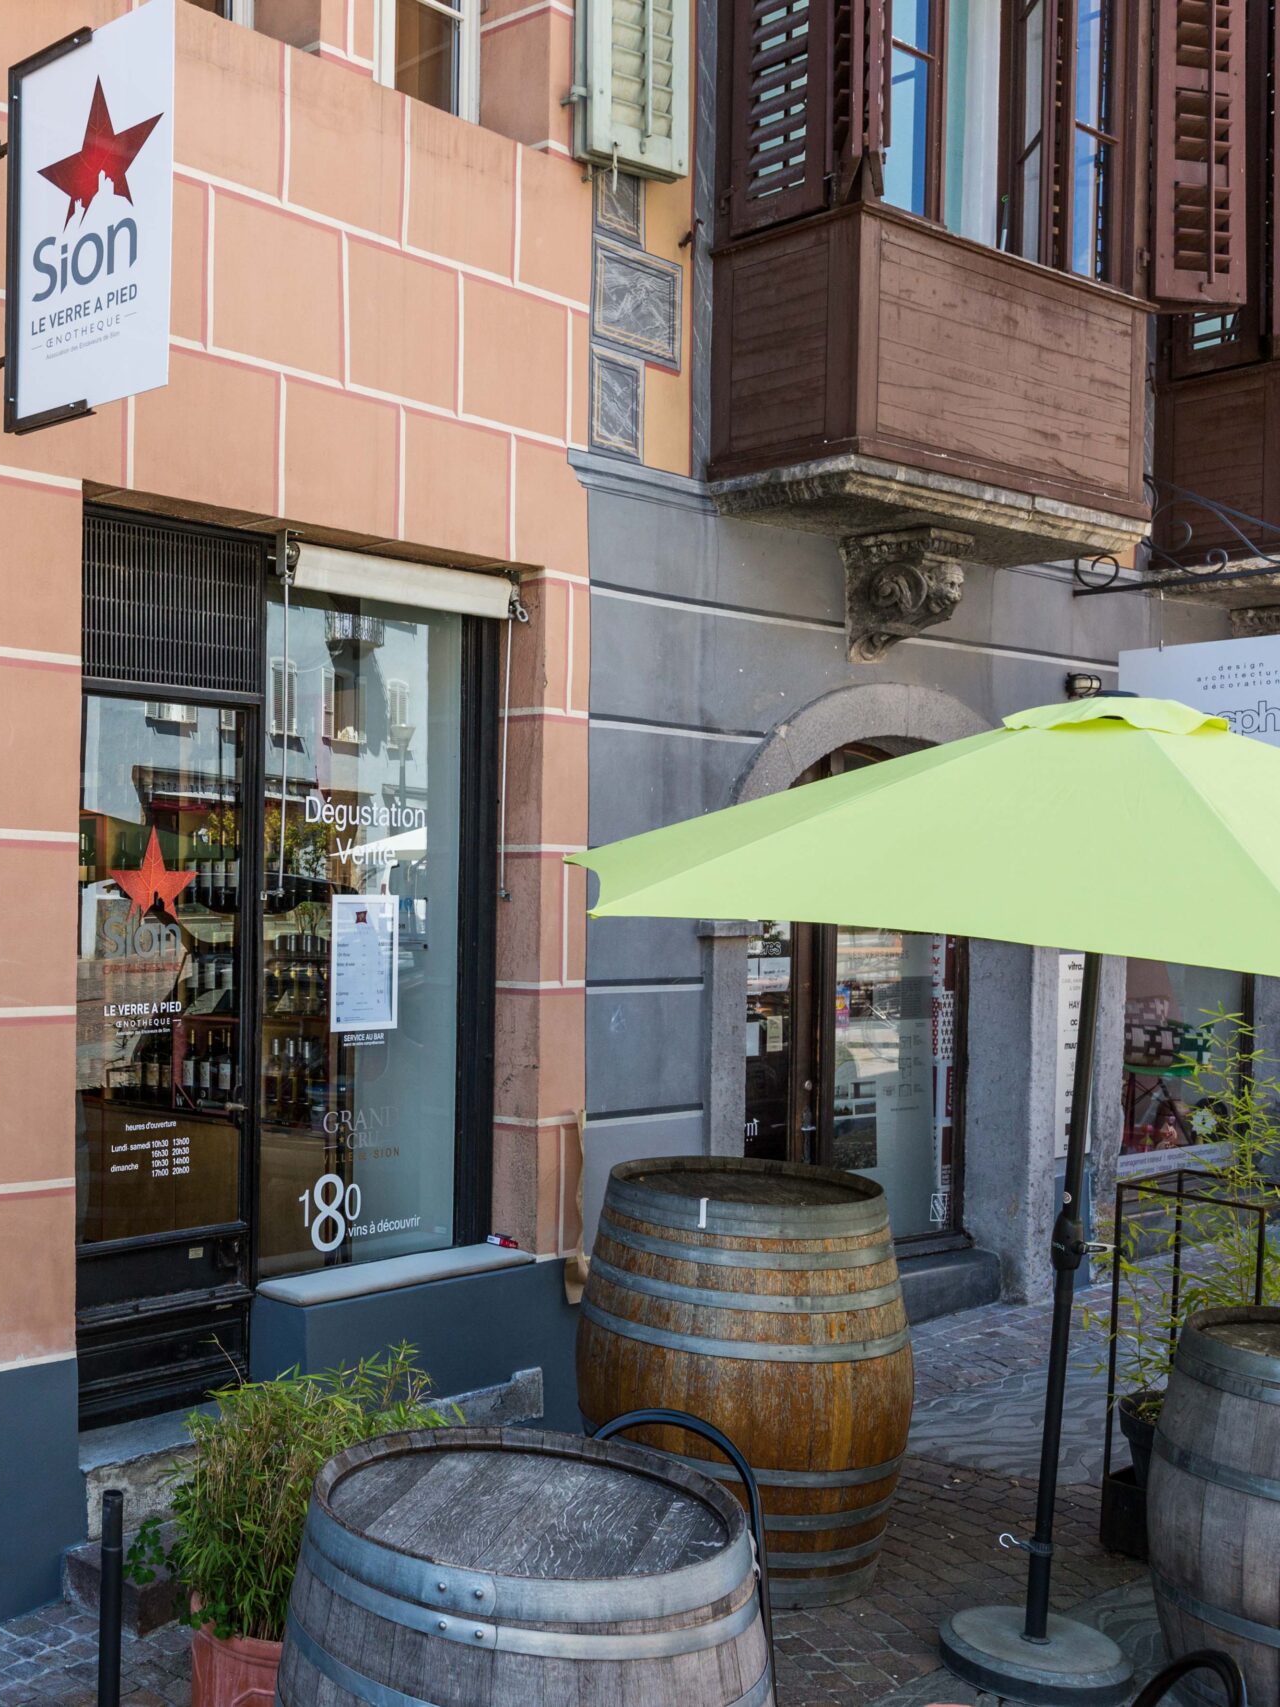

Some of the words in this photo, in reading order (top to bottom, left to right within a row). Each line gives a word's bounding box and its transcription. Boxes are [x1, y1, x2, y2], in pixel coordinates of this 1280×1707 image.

[31, 218, 138, 302] Sion
[31, 316, 46, 336] LE
[49, 300, 91, 329] VERRE
[94, 296, 103, 313] A
[107, 283, 138, 308] PIED
[1218, 662, 1264, 672] design
[305, 796, 426, 832] Dégustation
[336, 837, 396, 865] Vente
[104, 916, 182, 959] Sion
[104, 1005, 116, 1017] LE
[117, 1003, 150, 1016] VERRE
[151, 1002, 158, 1014] A
[160, 1001, 182, 1013] PIED
[343, 1033, 365, 1042] SERVICE
[366, 1033, 374, 1041] AU
[374, 1032, 385, 1041] BAR
[125, 1123, 146, 1132] heures
[146, 1120, 177, 1130] d'ouverture
[323, 1106, 400, 1134] GRAND
[129, 1141, 151, 1151] samedi
[151, 1139, 169, 1149] 10h30
[172, 1137, 190, 1146] 13h00
[346, 1131, 379, 1150] CRU
[151, 1149, 169, 1158] 16h30
[172, 1146, 190, 1156] 20h30
[373, 1146, 400, 1159] SION
[110, 1163, 139, 1173] dimanche
[151, 1158, 169, 1168] 10h30
[172, 1156, 190, 1166] 14h00
[151, 1168, 169, 1178] 17h00
[172, 1166, 190, 1175] 20h00
[299, 1173, 362, 1252] 180
[348, 1224, 368, 1237] vins
[369, 1220, 376, 1234] à
[377, 1214, 421, 1233] découvrir
